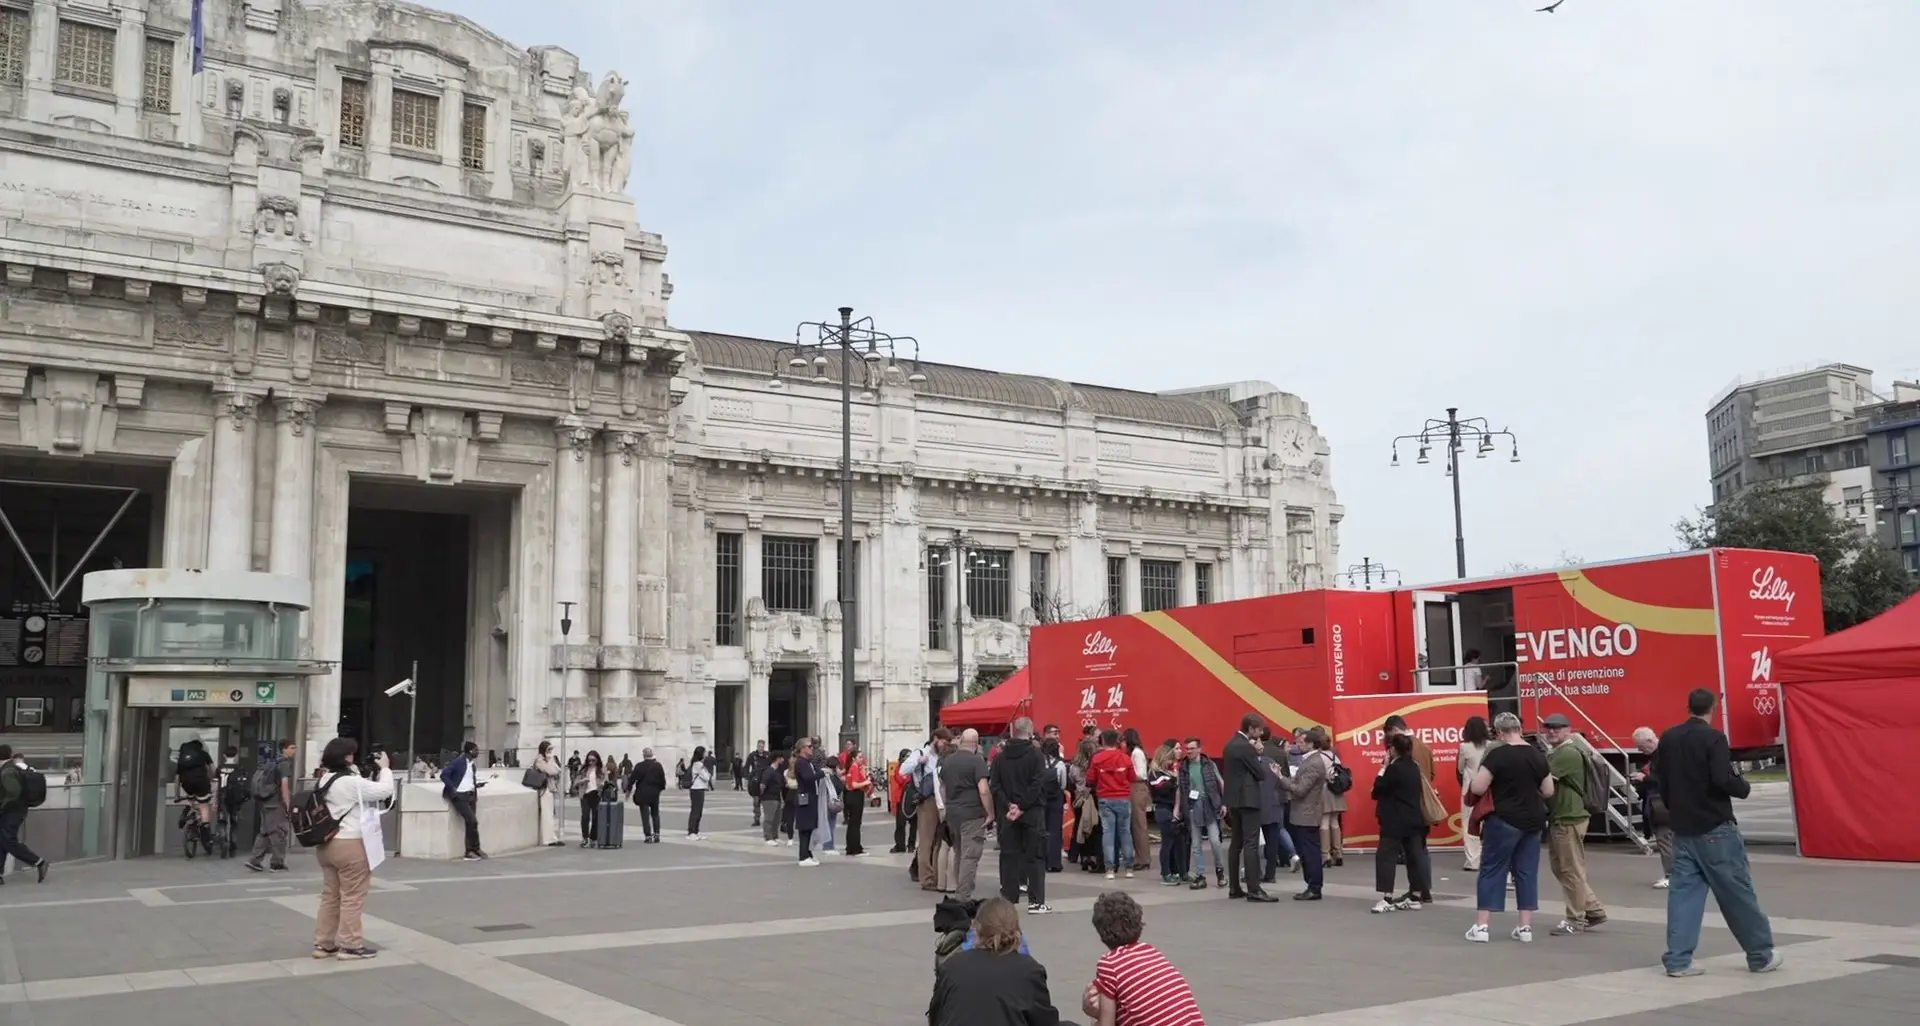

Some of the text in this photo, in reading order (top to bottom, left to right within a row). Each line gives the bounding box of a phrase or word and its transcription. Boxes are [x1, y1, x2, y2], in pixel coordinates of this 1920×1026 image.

[1750, 565, 1795, 613] Lilly
[1082, 630, 1117, 661] Lilly
[1515, 623, 1638, 662] EVENGO
[1332, 624, 1345, 692] PREVENGO
[1556, 669, 1566, 681] di
[1567, 666, 1625, 682] prevenzione
[188, 691, 205, 700] M2
[1564, 684, 1580, 695] tua
[1581, 682, 1610, 695] salute
[1352, 731, 1371, 746] IO
